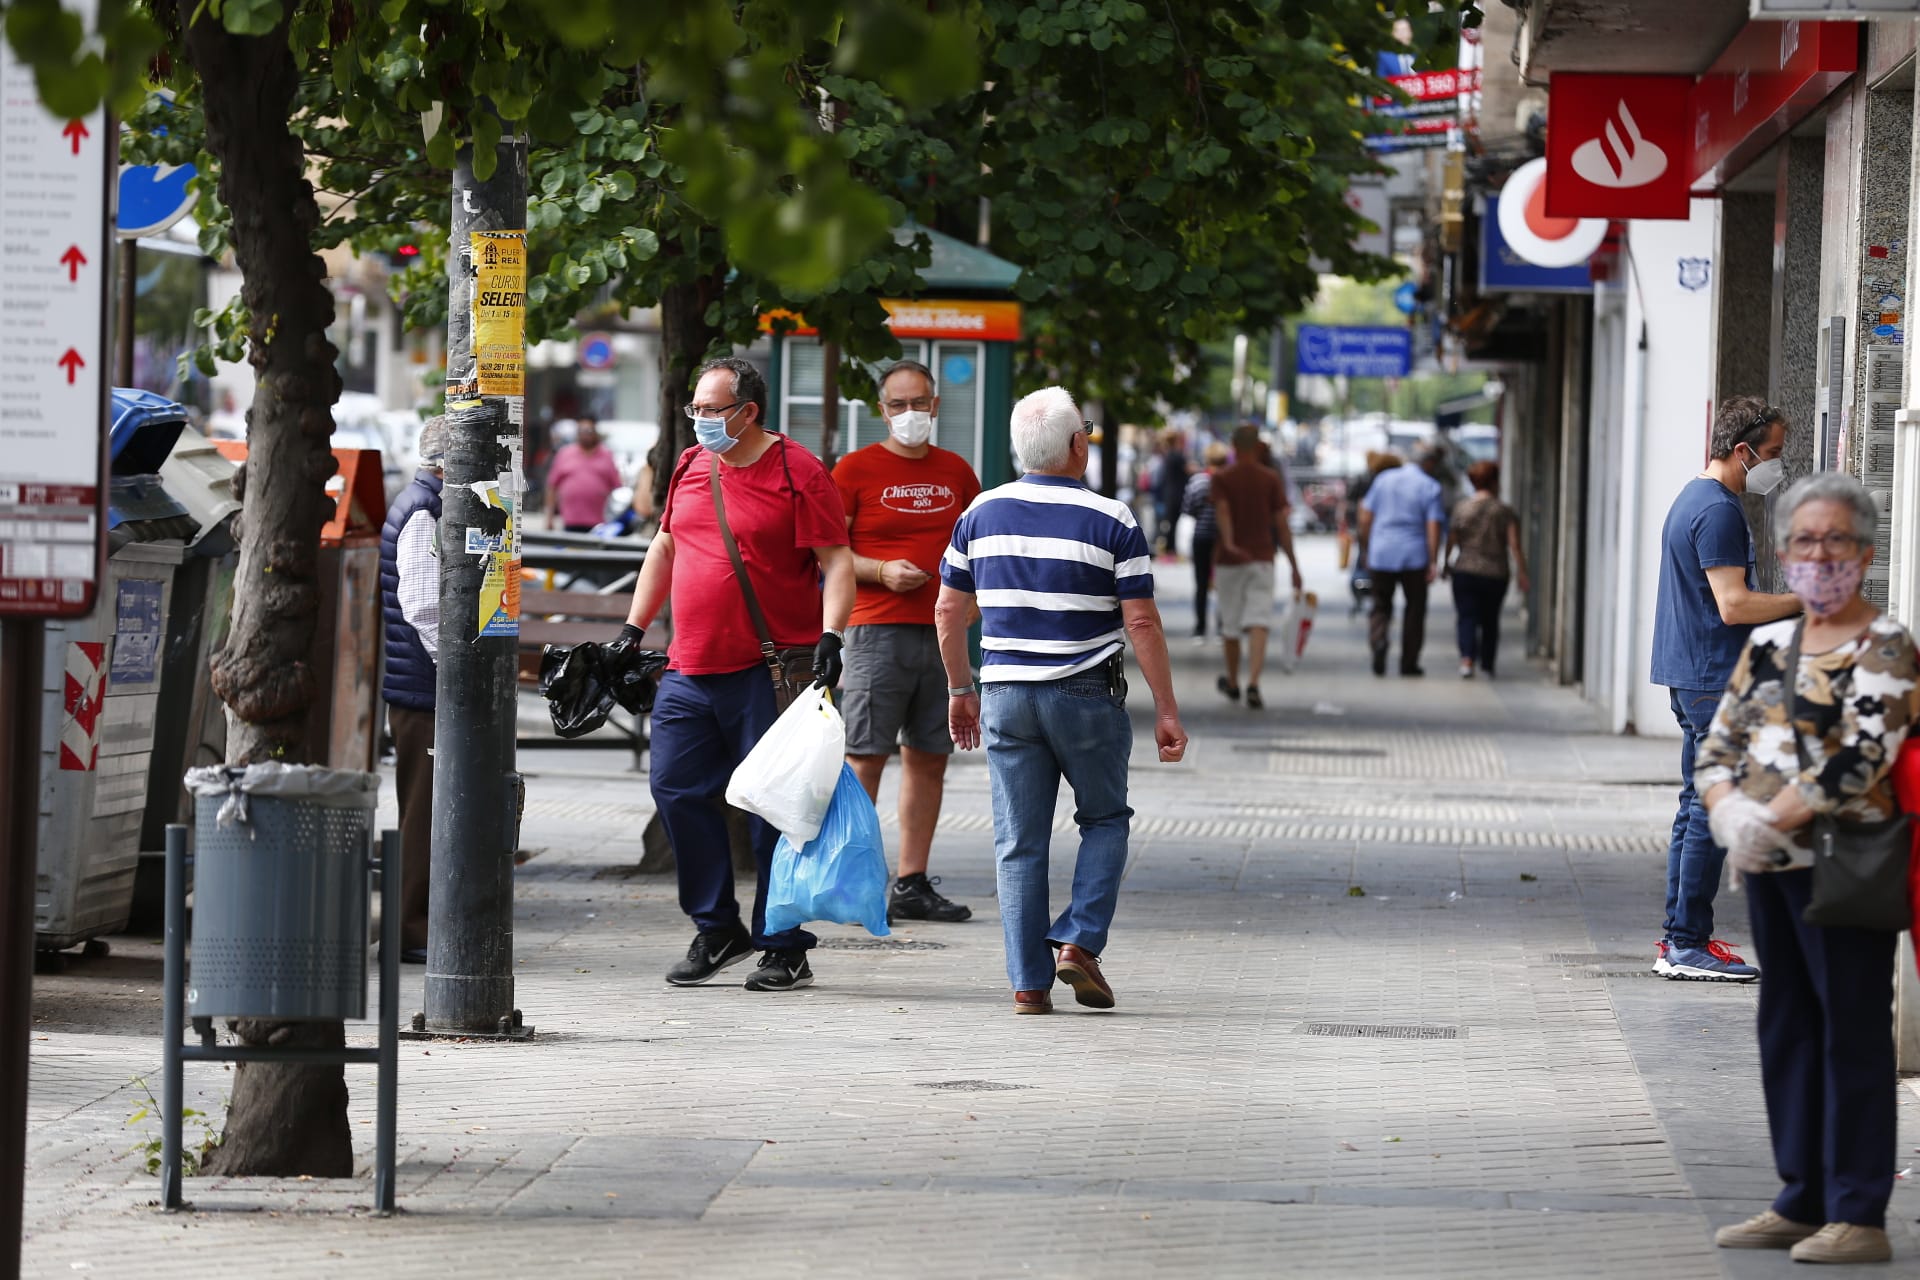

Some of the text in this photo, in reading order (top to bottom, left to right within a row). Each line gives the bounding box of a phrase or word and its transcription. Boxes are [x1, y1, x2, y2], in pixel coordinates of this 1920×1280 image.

[501, 257, 520, 265] REAL
[490, 274, 521, 289] CURSO
[912, 497, 932, 509] 1981
